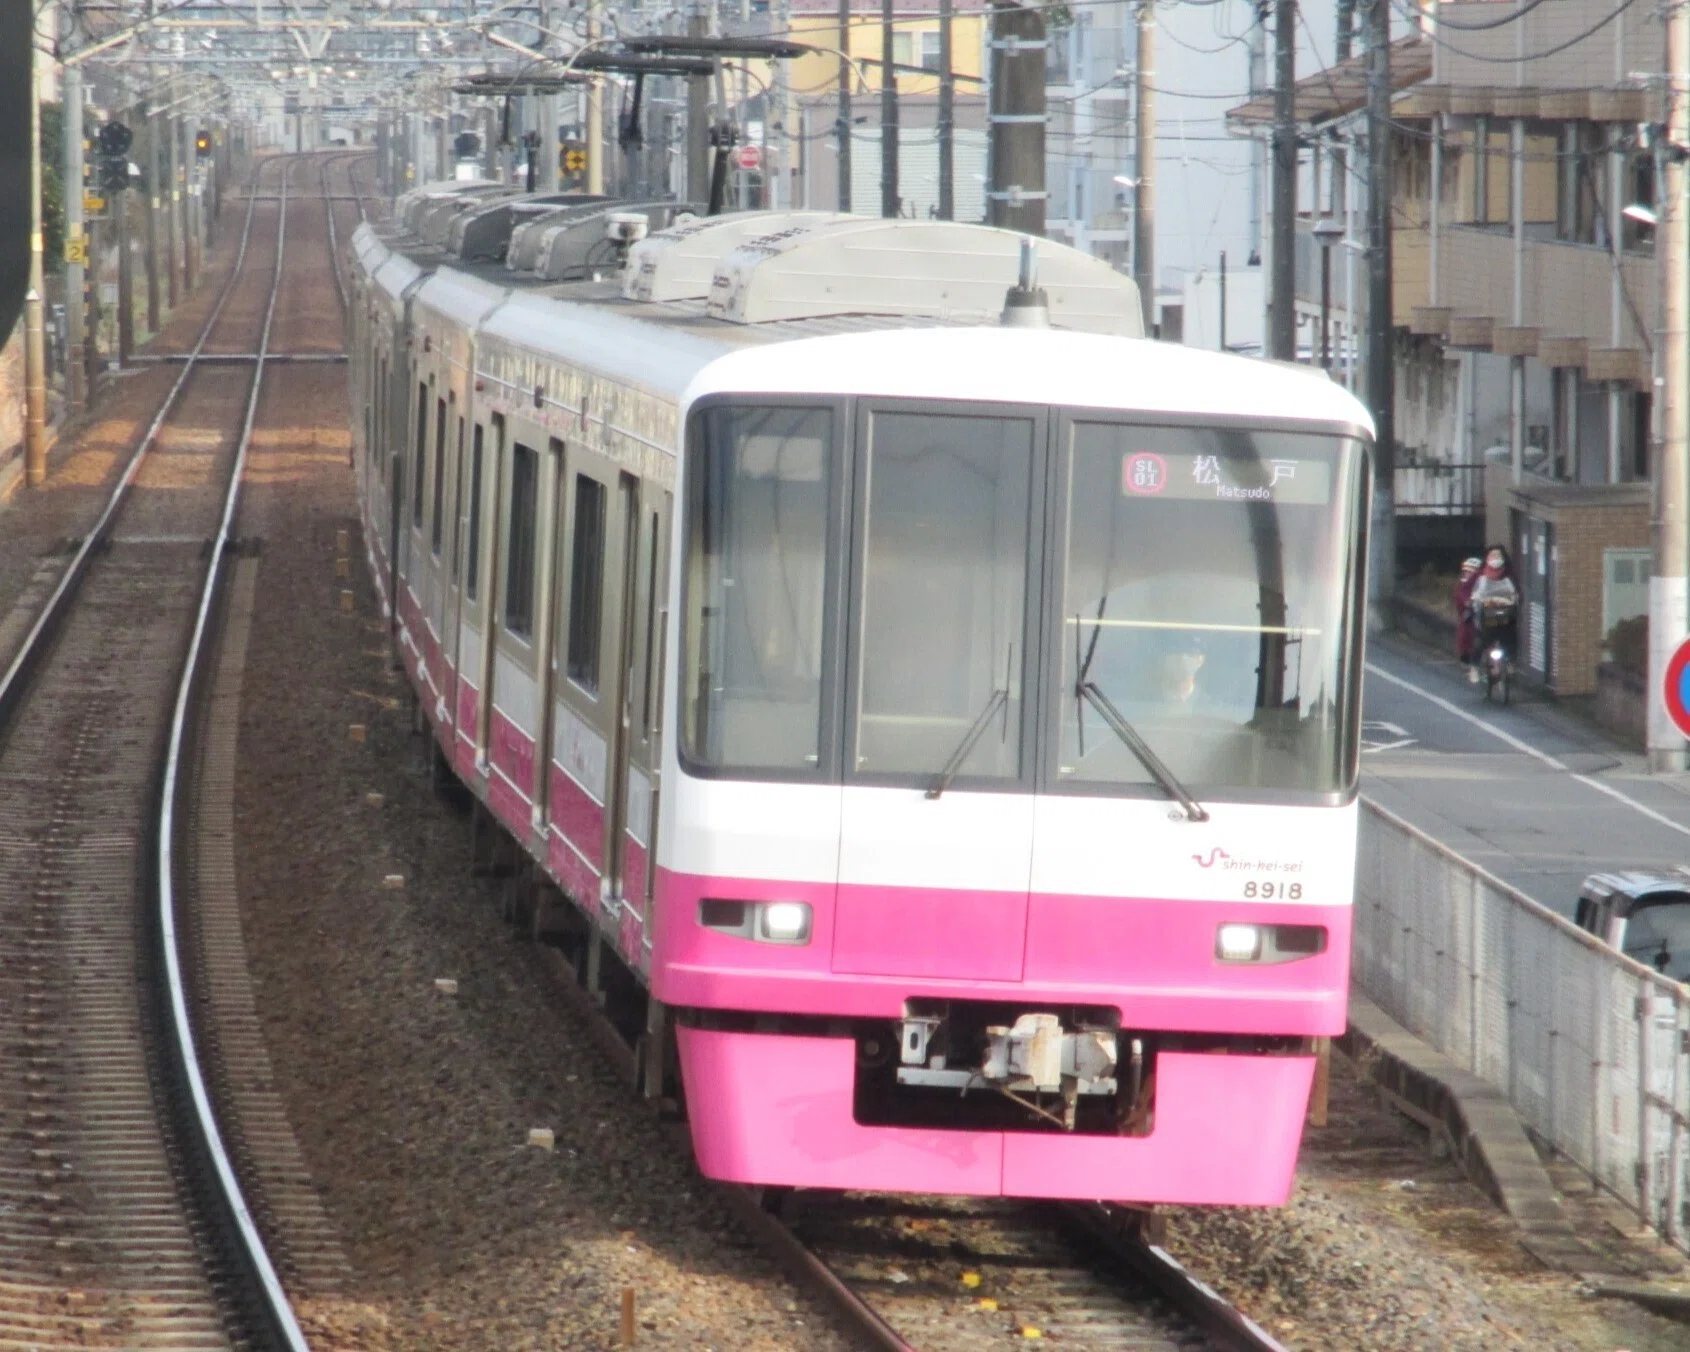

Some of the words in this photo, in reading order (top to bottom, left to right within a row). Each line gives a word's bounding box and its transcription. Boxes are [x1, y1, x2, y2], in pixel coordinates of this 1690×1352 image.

[1135, 459, 1158, 472] SL
[1192, 455, 1299, 487] 松戸
[1134, 472, 1157, 486] 01
[1216, 485, 1270, 499] Matsudo
[1223, 859, 1303, 872] shin-kei-sei
[1243, 881, 1302, 900] 8918
